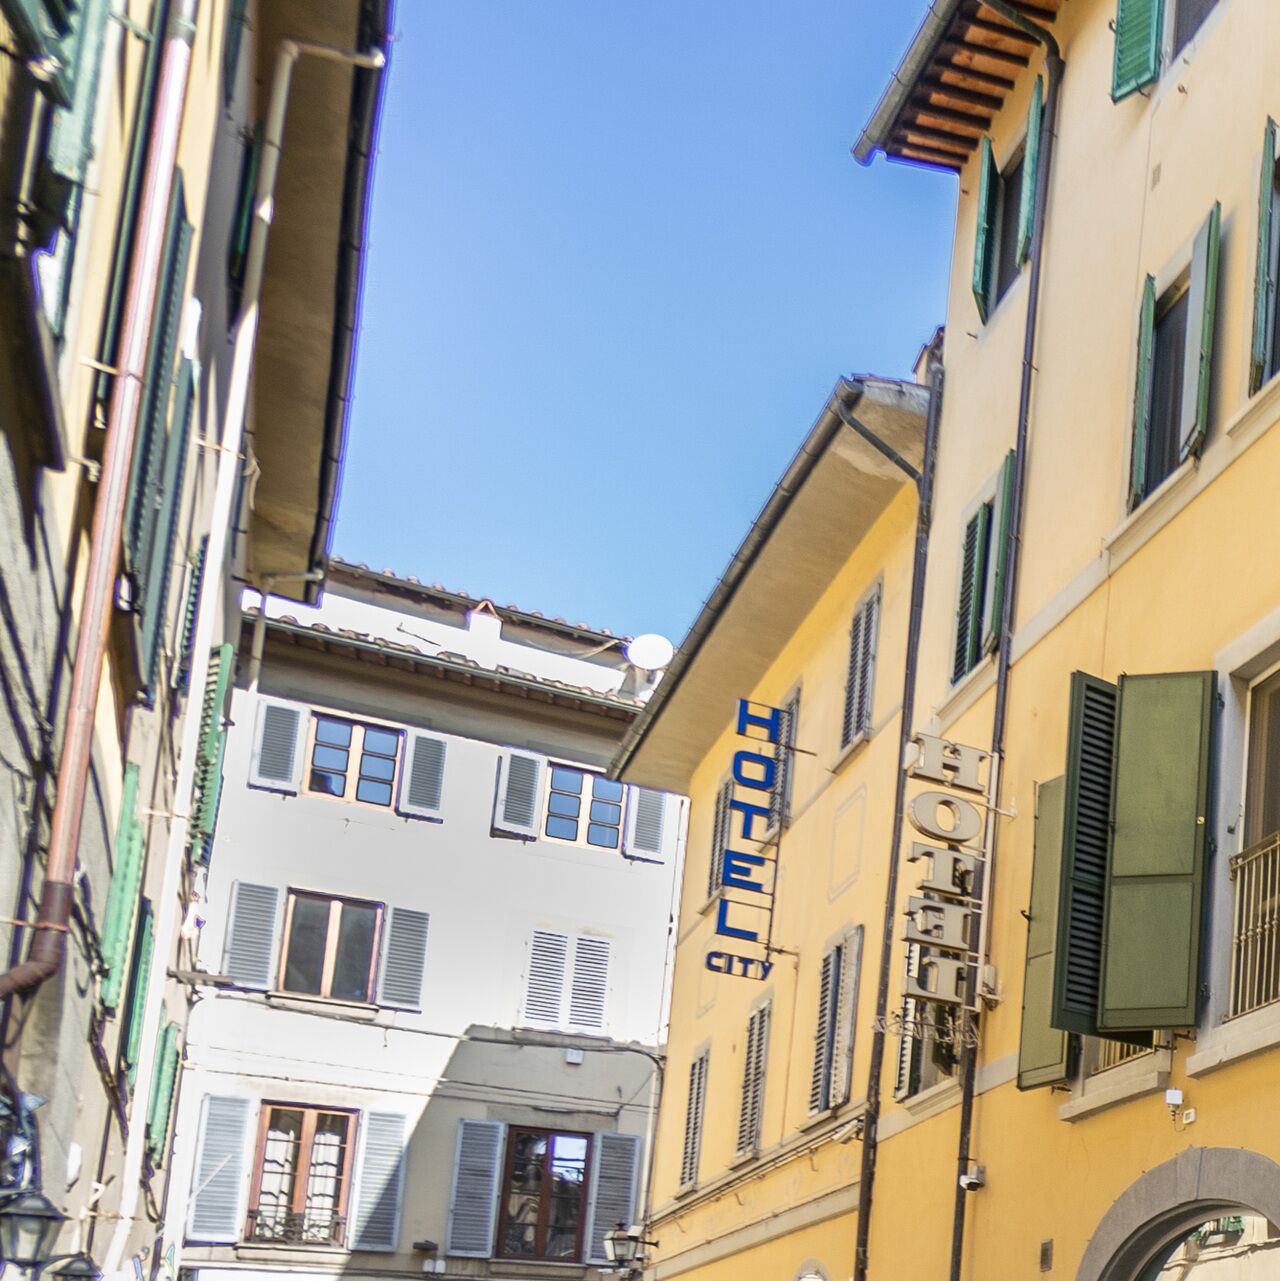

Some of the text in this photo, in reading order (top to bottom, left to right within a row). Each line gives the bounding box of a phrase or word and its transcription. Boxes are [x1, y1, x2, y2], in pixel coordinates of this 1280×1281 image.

[715, 698, 781, 941] HOTEL
[903, 733, 989, 1002] HOTEL
[705, 951, 774, 981] CITY
